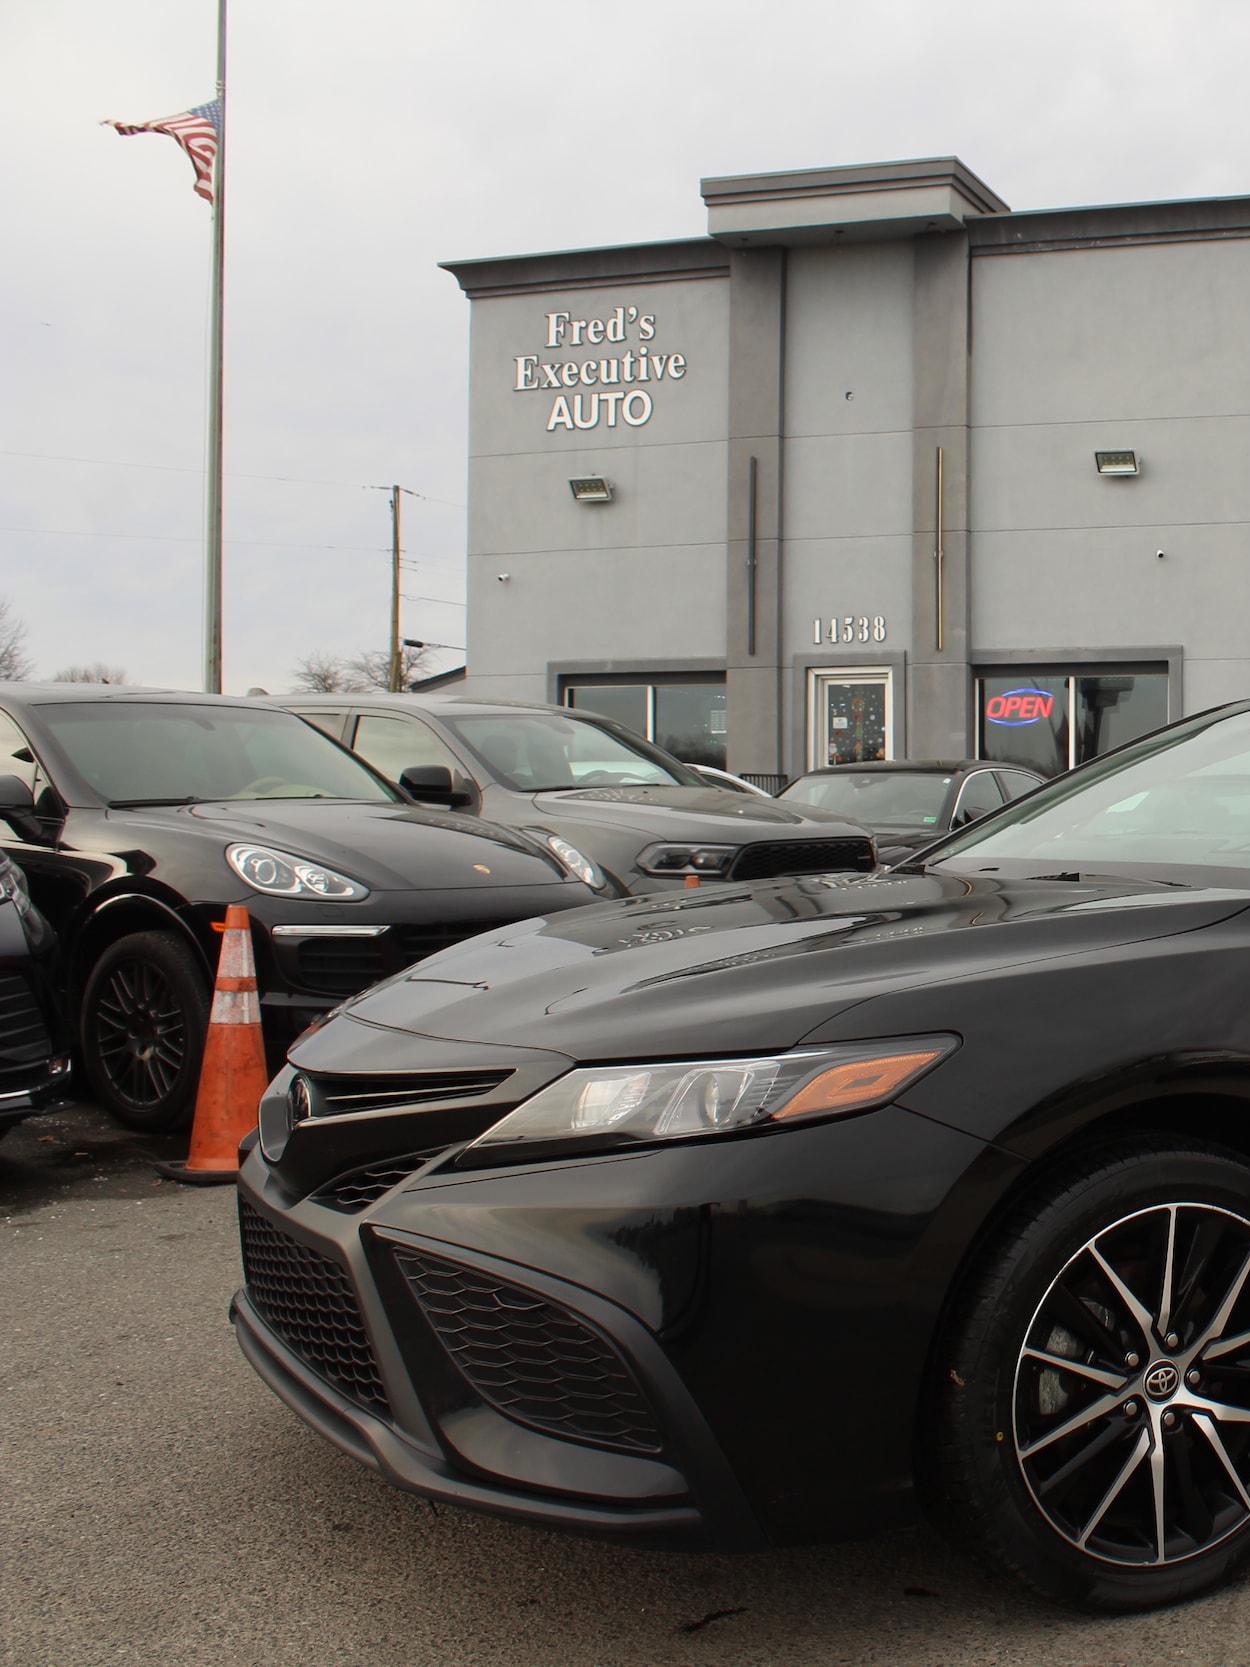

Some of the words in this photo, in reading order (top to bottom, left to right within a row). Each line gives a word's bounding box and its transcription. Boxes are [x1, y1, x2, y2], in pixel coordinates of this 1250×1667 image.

[544, 306, 656, 348] Fred's
[513, 346, 687, 391] Executive
[546, 389, 653, 431] AUTO
[813, 615, 887, 645] 14538
[985, 696, 1054, 719] OPEN
